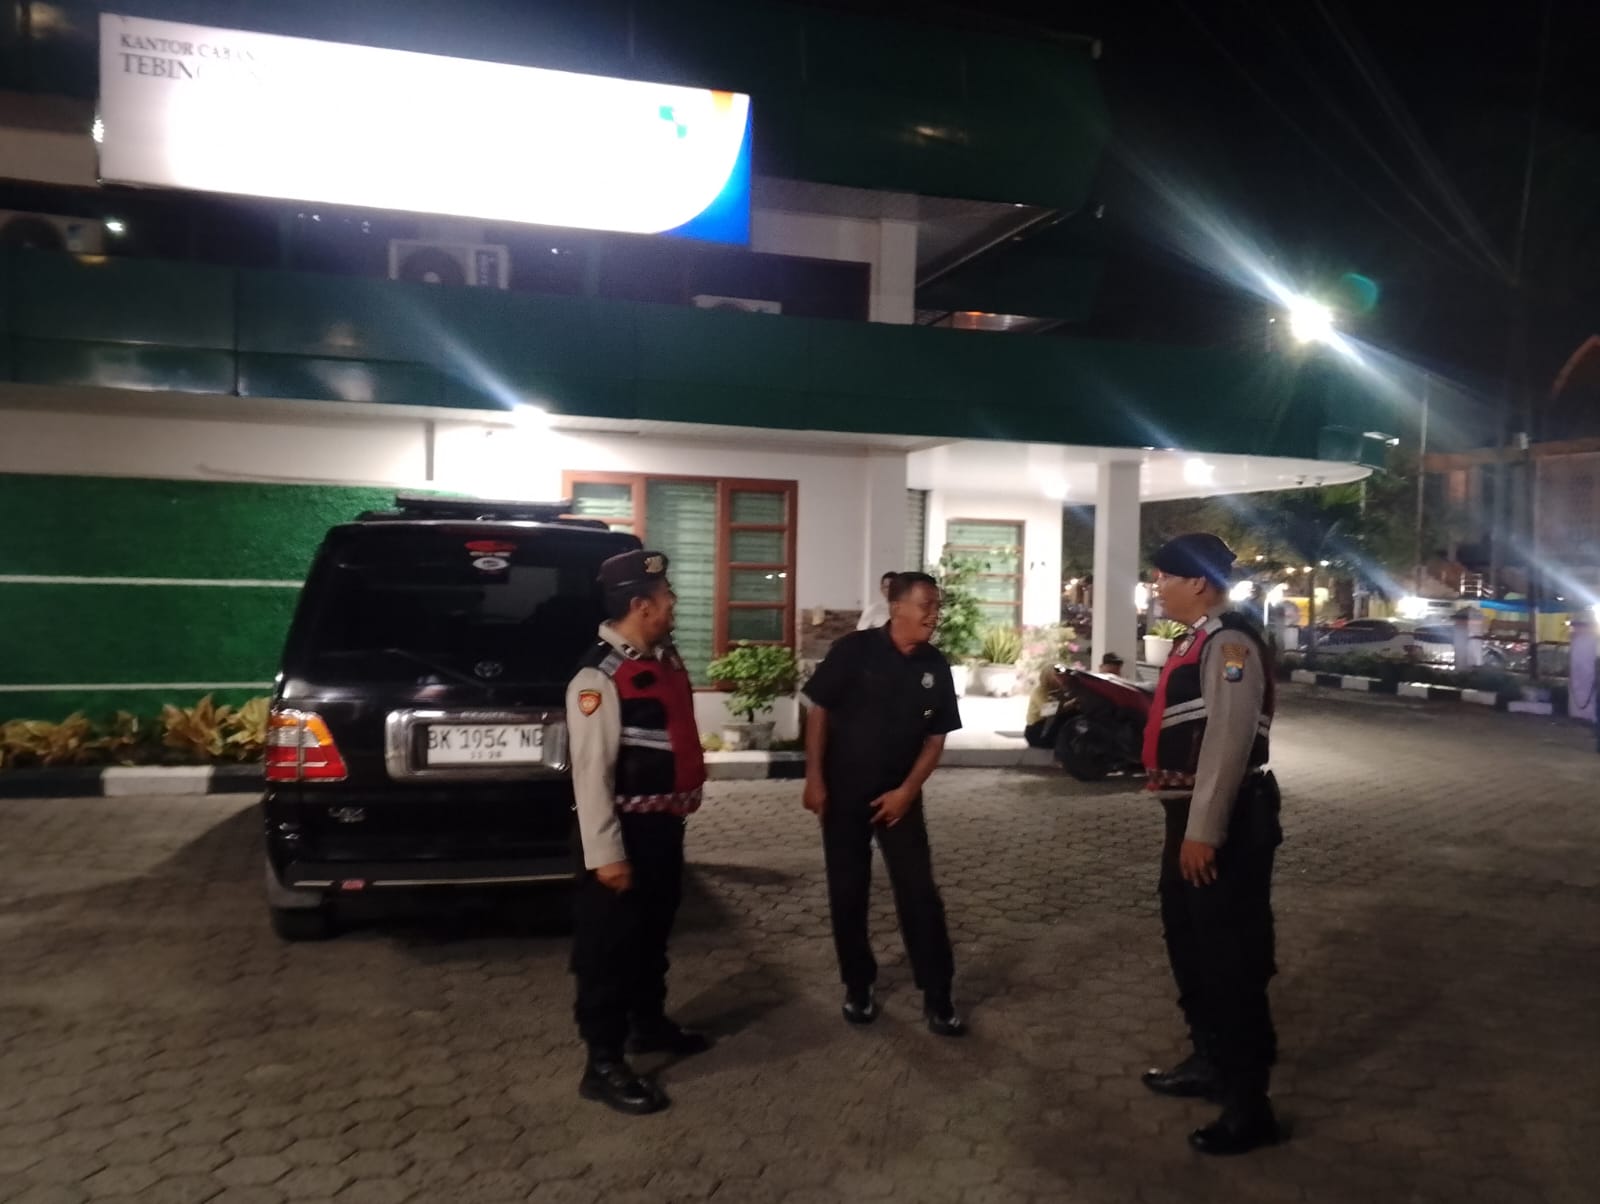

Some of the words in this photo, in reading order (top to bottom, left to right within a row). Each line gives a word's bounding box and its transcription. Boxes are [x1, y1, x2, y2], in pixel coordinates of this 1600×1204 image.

[120, 32, 194, 56] KANTOR
[119, 51, 200, 79] TEBIN
[427, 729, 451, 750] BK
[460, 728, 508, 750] 1954
